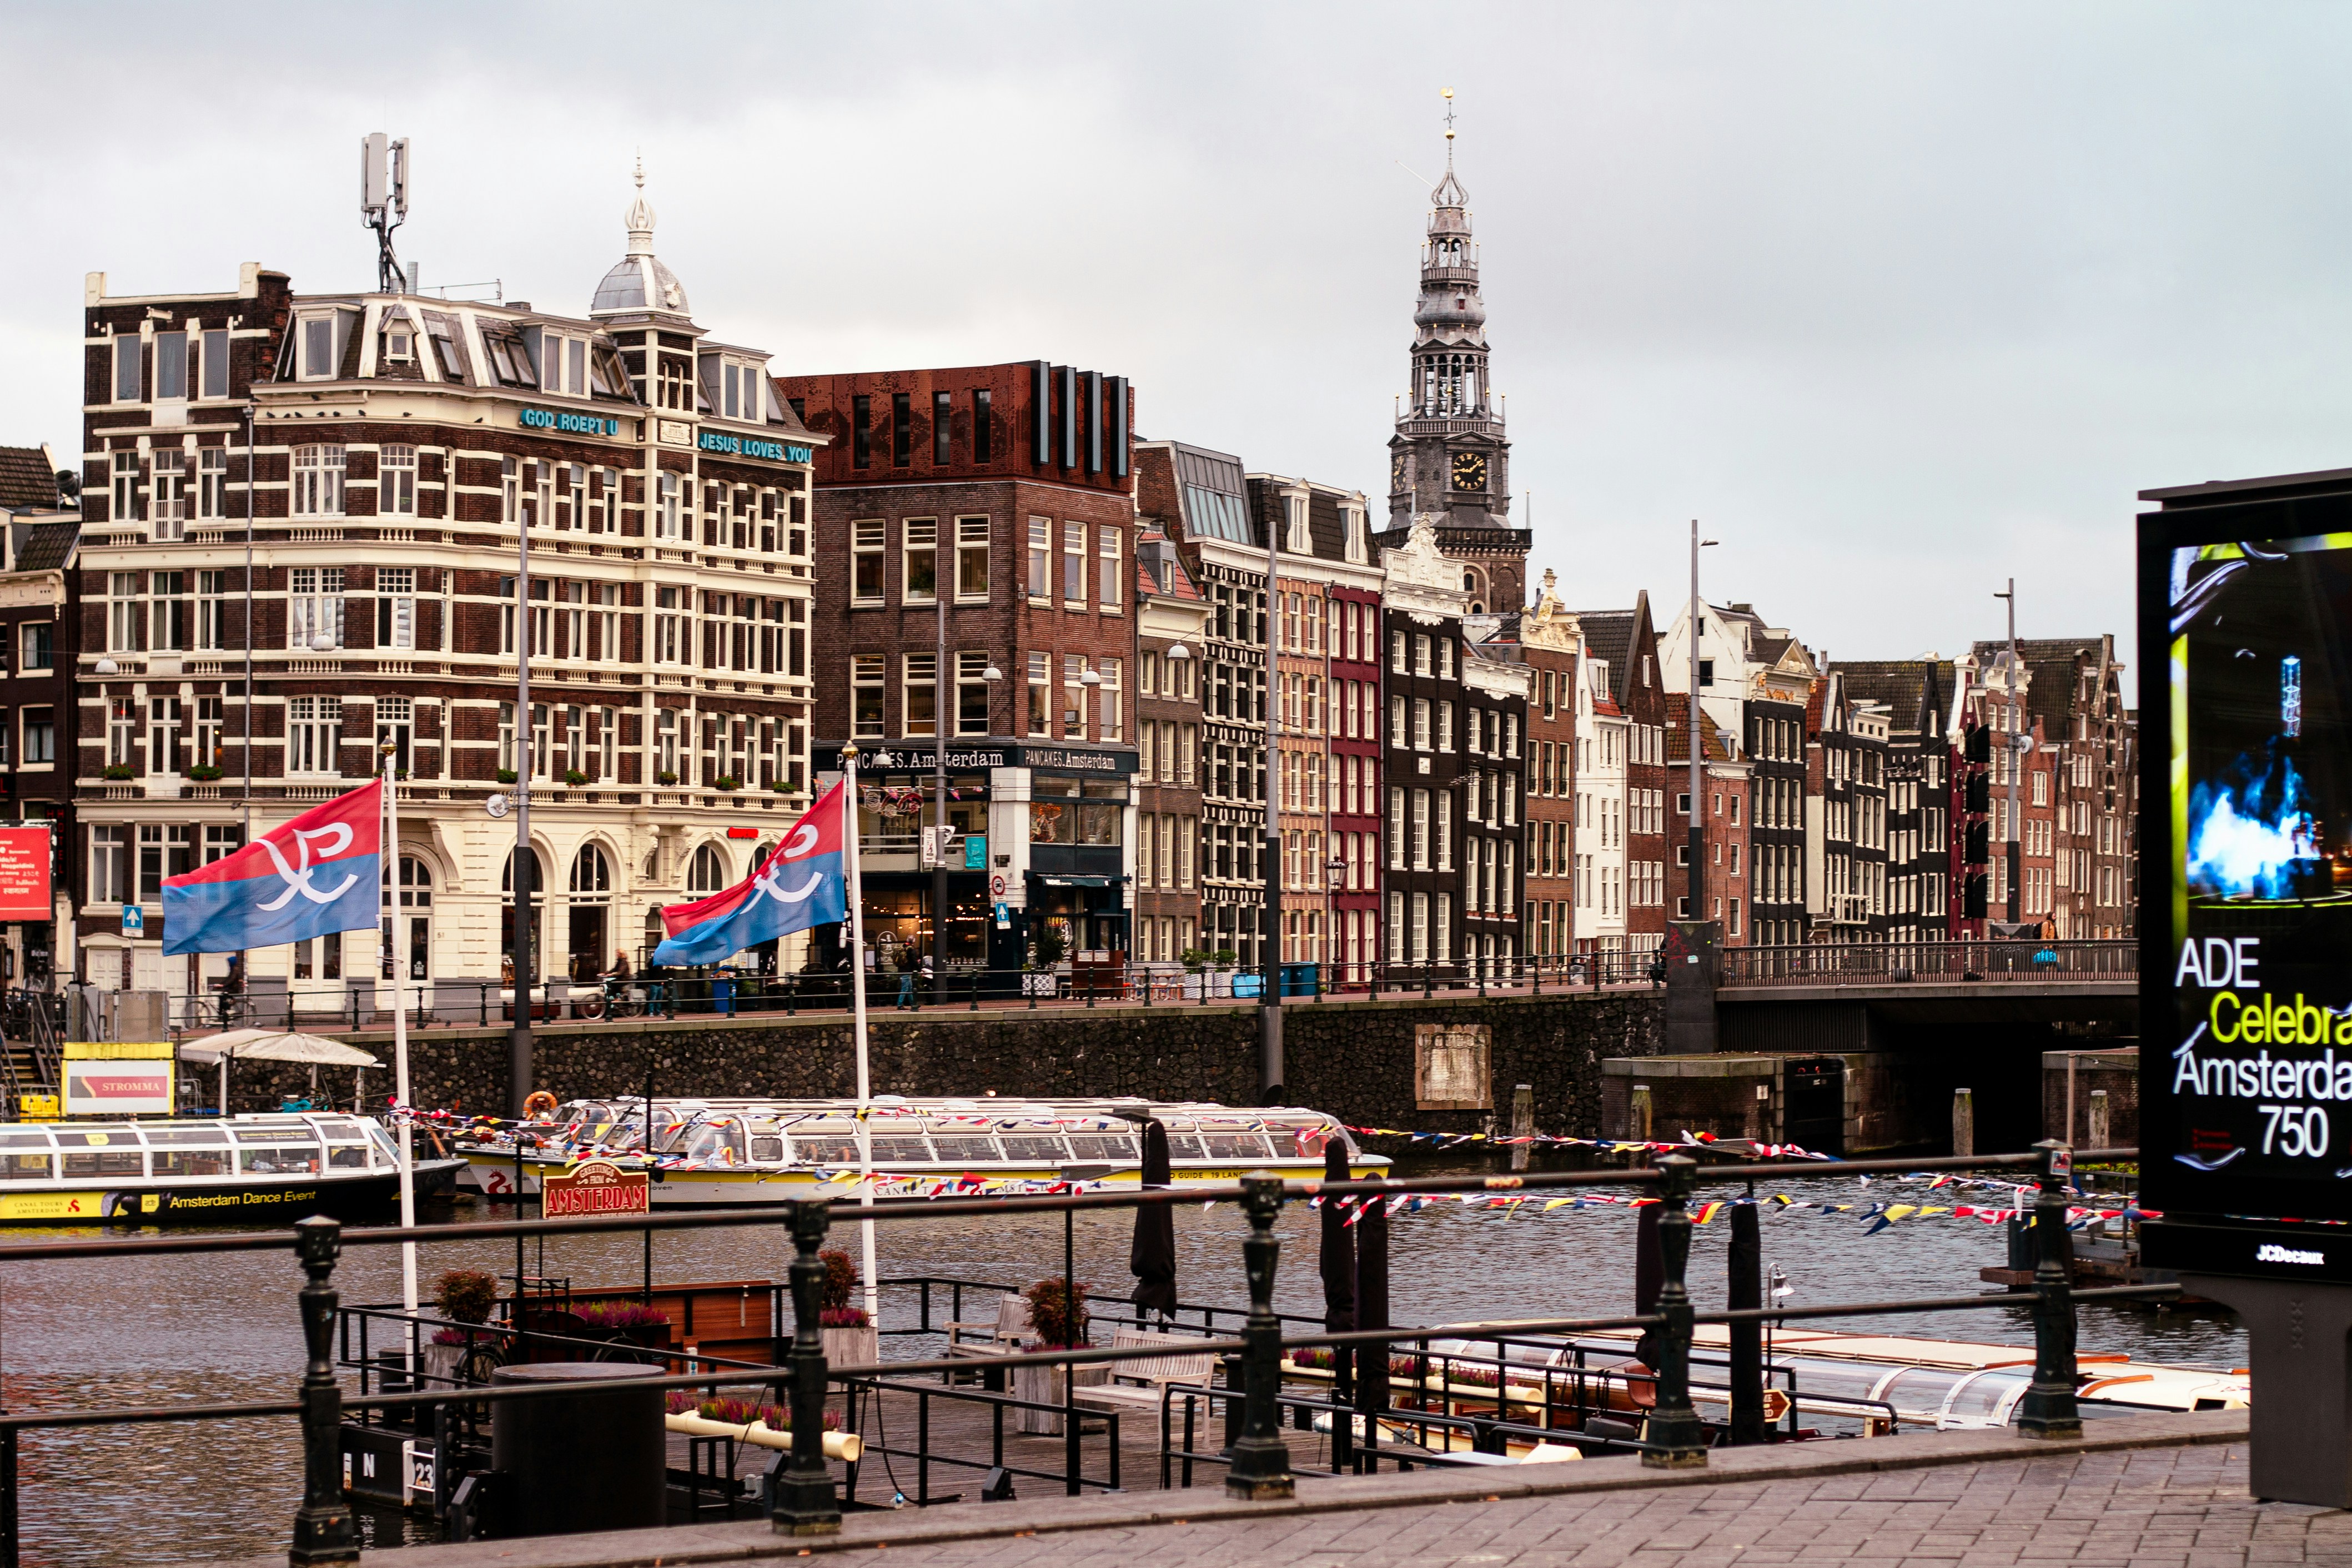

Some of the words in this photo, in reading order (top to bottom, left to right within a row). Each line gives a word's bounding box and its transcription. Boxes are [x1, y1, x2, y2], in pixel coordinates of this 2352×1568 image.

[521, 409, 554, 427] GOD
[557, 414, 604, 434] ROEPT
[606, 420, 618, 435] U
[698, 433, 738, 453] JESUS
[741, 439, 783, 460] LOVES
[785, 446, 812, 463] YOU
[2175, 937, 2260, 988] ADE
[102, 1082, 160, 1092] STROMMA
[2173, 1049, 2352, 1100] Amsterda
[2259, 1105, 2329, 1158] 750
[579, 1164, 615, 1178] GREETINGS
[589, 1175, 605, 1184] FROM
[169, 1195, 239, 1209] Amsterdam
[243, 1193, 282, 1204] Dance
[284, 1191, 316, 1202] Event
[546, 1185, 646, 1213] AMSTERDAM
[2256, 1244, 2325, 1265] JCDecaux
